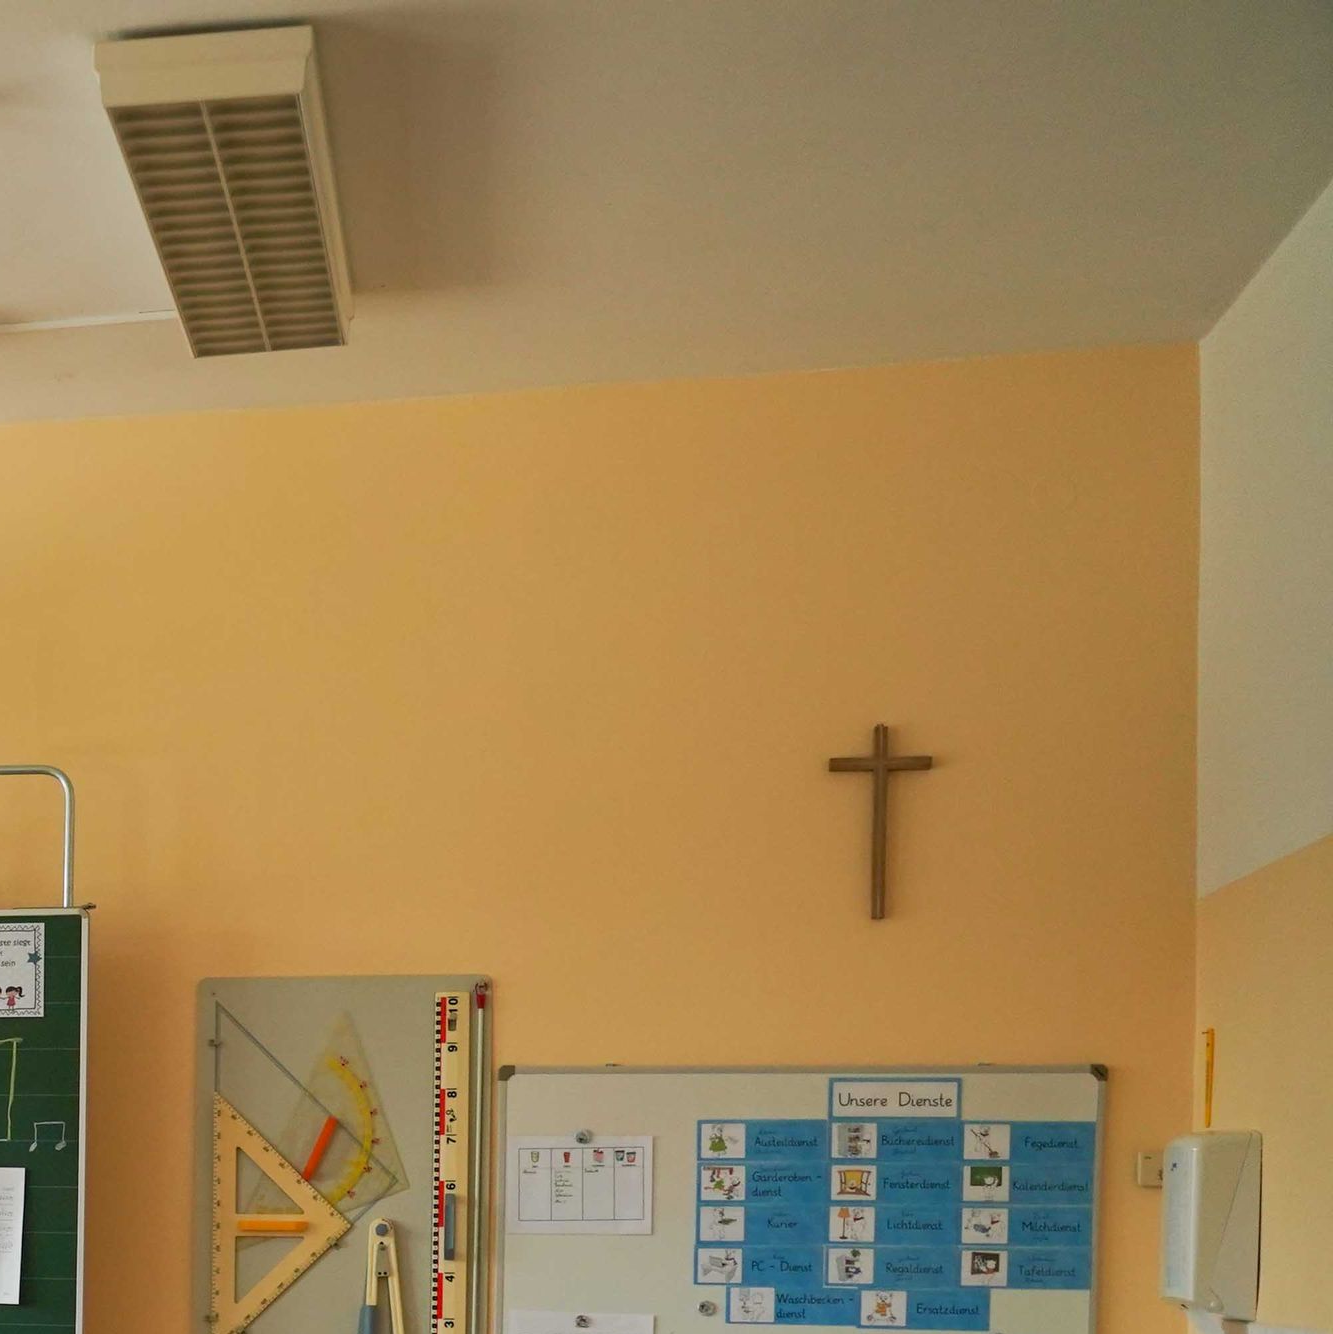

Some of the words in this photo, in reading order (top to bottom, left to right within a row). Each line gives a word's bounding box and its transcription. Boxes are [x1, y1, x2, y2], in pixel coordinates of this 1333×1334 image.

[447, 1044, 458, 1052] 9
[447, 1090, 457, 1098] 8
[838, 1092, 888, 1107] Unsere
[898, 1091, 953, 1107] Dienste
[446, 1136, 457, 1144] 7
[1024, 1136, 1079, 1150] Fegedienst
[445, 1182, 456, 1190] 6
[883, 1178, 951, 1190] Fensterdienst
[1012, 1180, 1089, 1192] Kalenderdienst
[751, 1185, 782, 1197] dienst
[886, 1219, 943, 1231] Lichtdienst
[1022, 1221, 1082, 1233] Milchdienst
[751, 1260, 765, 1272] PC
[780, 1260, 813, 1272] Dienst
[444, 1274, 455, 1282] 4
[776, 1293, 844, 1305] Waschbecken
[776, 1308, 806, 1319] dienst
[916, 1303, 980, 1316] Ersatzdienst
